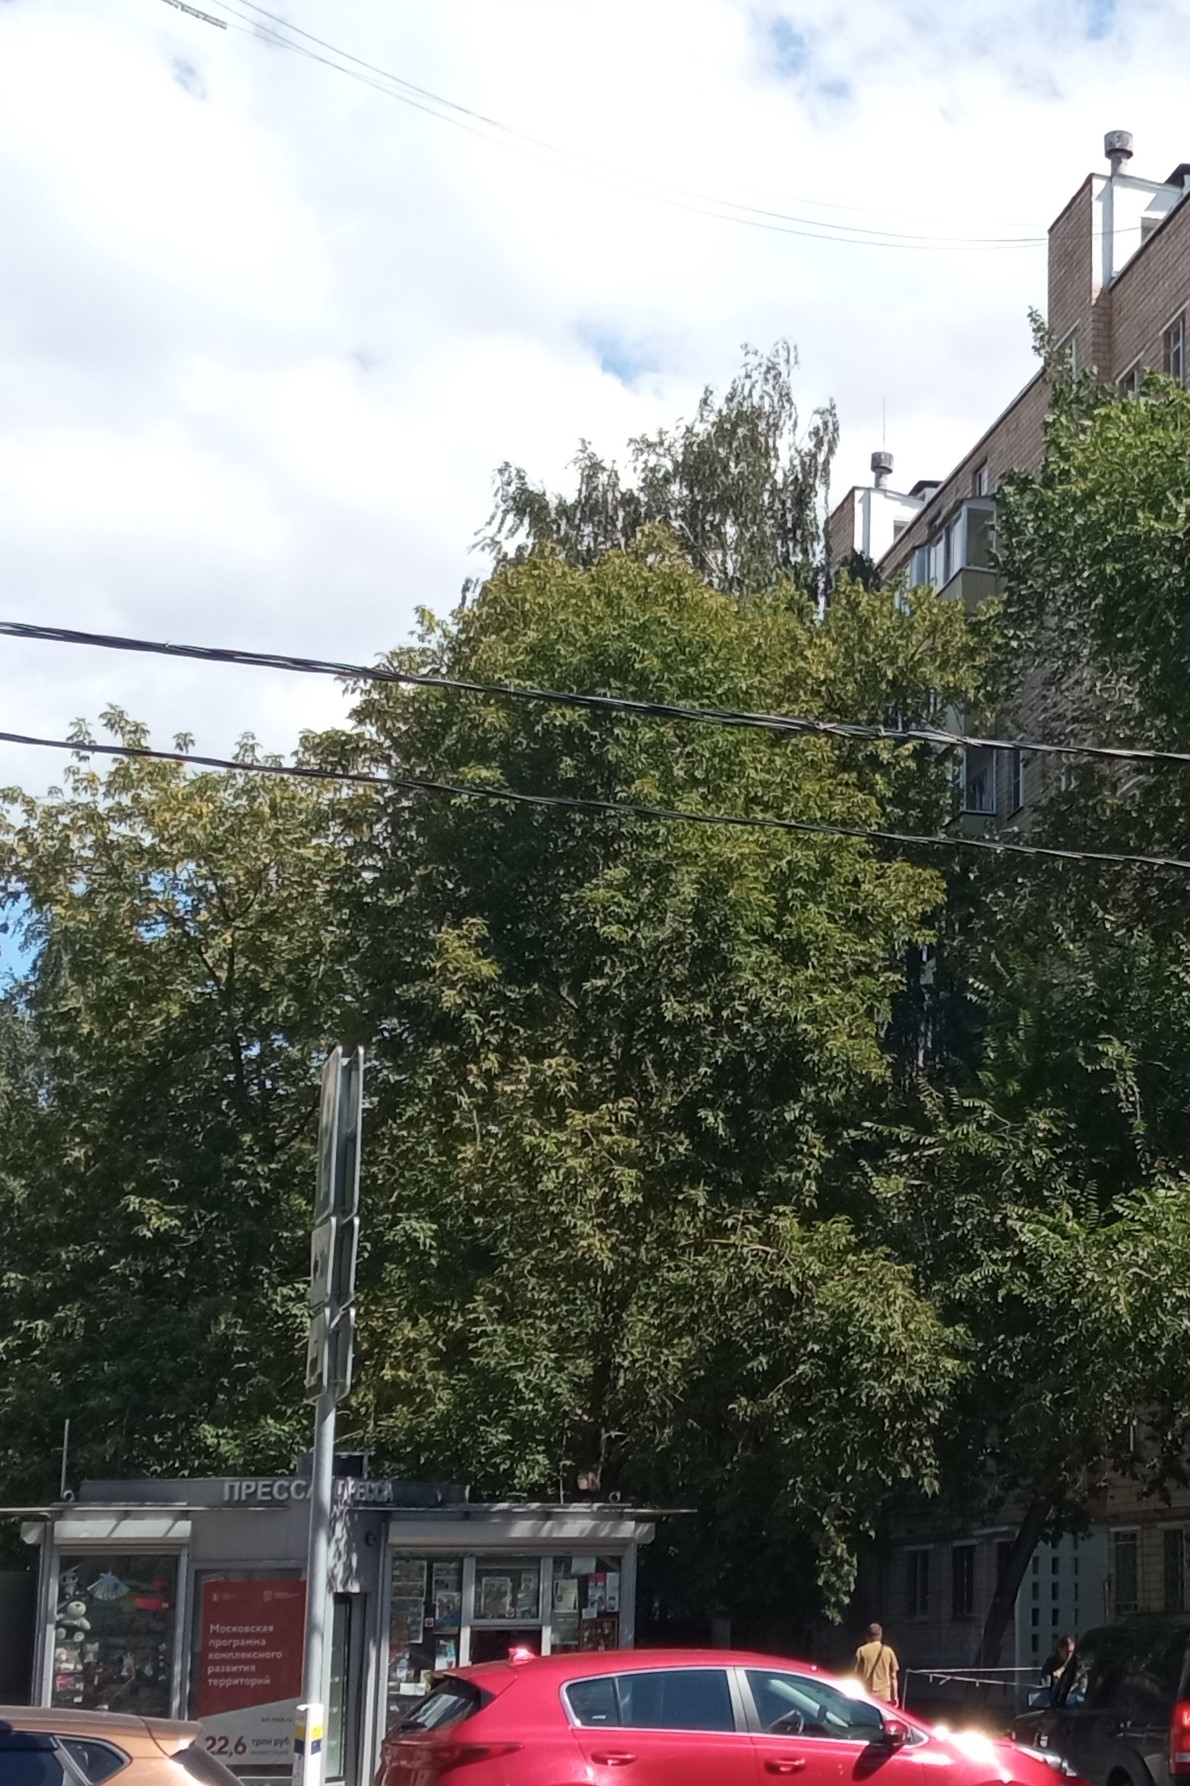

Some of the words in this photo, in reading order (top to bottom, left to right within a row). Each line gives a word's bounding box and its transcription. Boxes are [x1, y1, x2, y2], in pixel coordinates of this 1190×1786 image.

[209, 1624, 274, 1634] Московская
[208, 1639, 267, 1649] программа
[207, 1651, 283, 1660] комплексного
[207, 1665, 256, 1675] развития
[207, 1675, 271, 1688] территорий
[204, 1735, 247, 1758] 22,6
